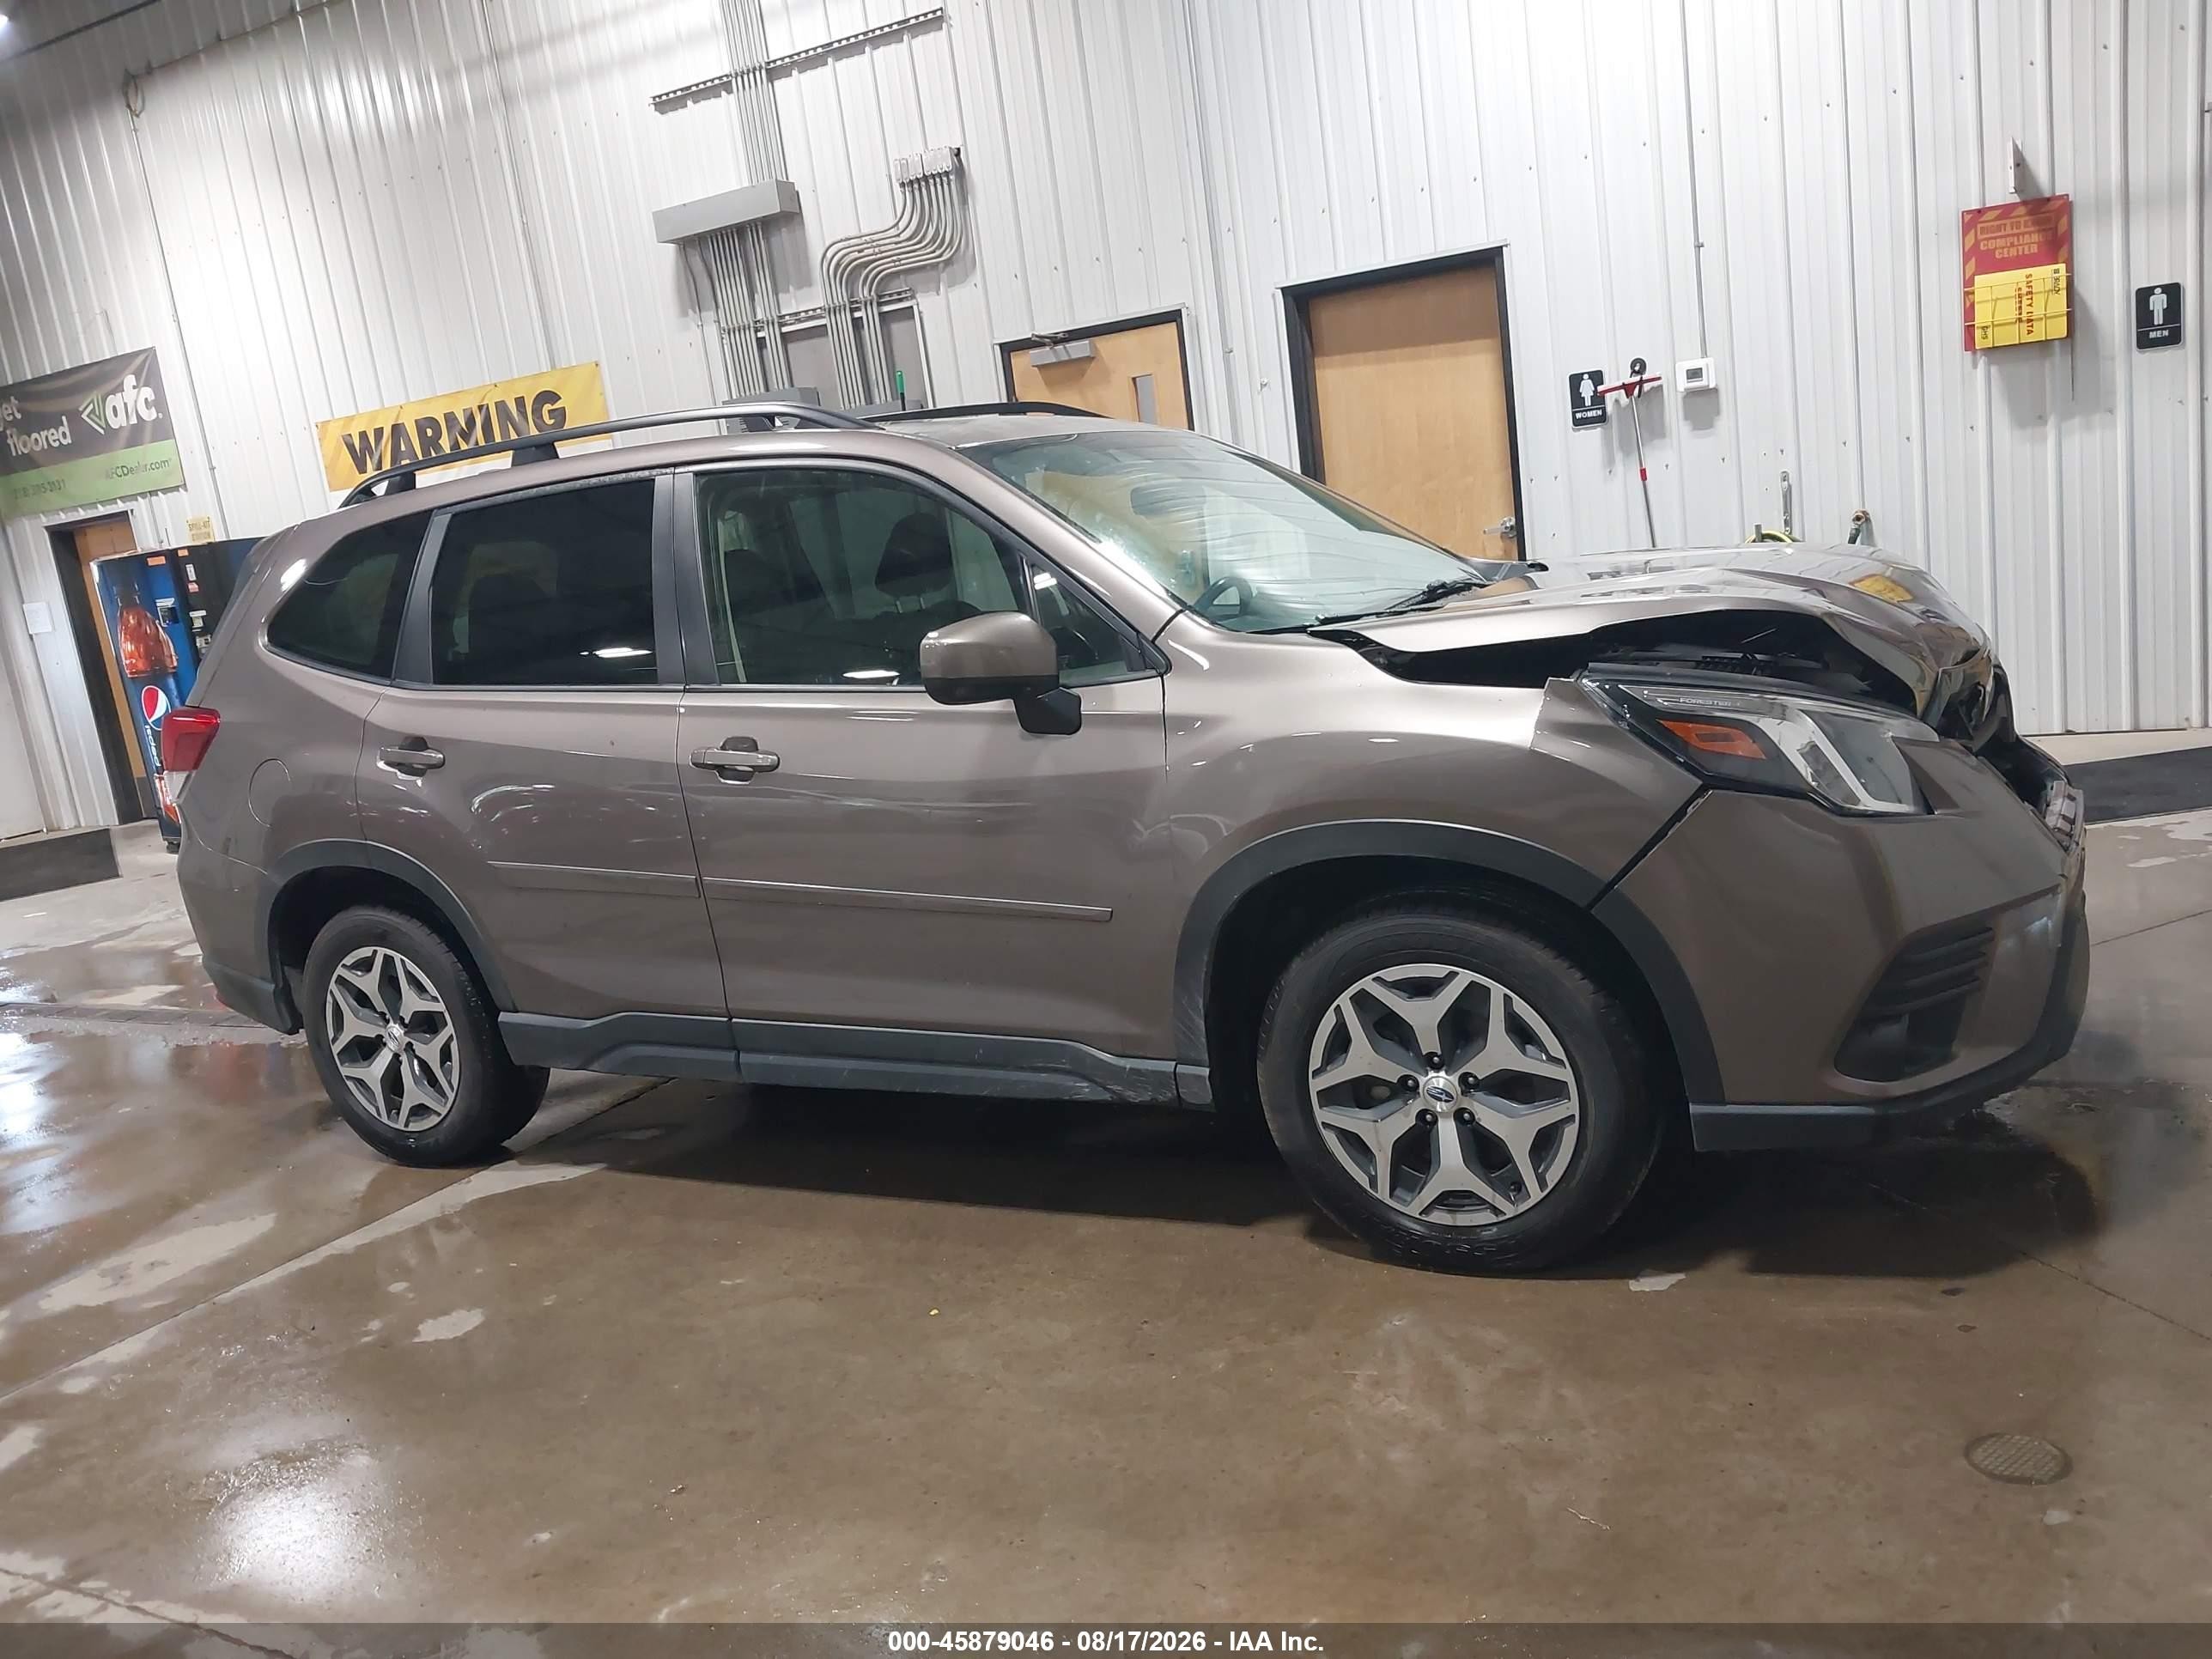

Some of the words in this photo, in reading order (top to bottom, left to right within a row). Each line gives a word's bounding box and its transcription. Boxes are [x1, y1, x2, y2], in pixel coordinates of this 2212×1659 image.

[1995, 244, 2039, 258] CENTER
[2025, 273, 2034, 307] SAFETY
[2149, 329, 2169, 339] MEN
[0, 396, 21, 431] et
[1575, 410, 1602, 420] WOMEN
[7, 416, 72, 456] floored
[343, 390, 567, 474] WARNING
[1679, 697, 1731, 707] FORESTER
[144, 725, 161, 767] pepsi
